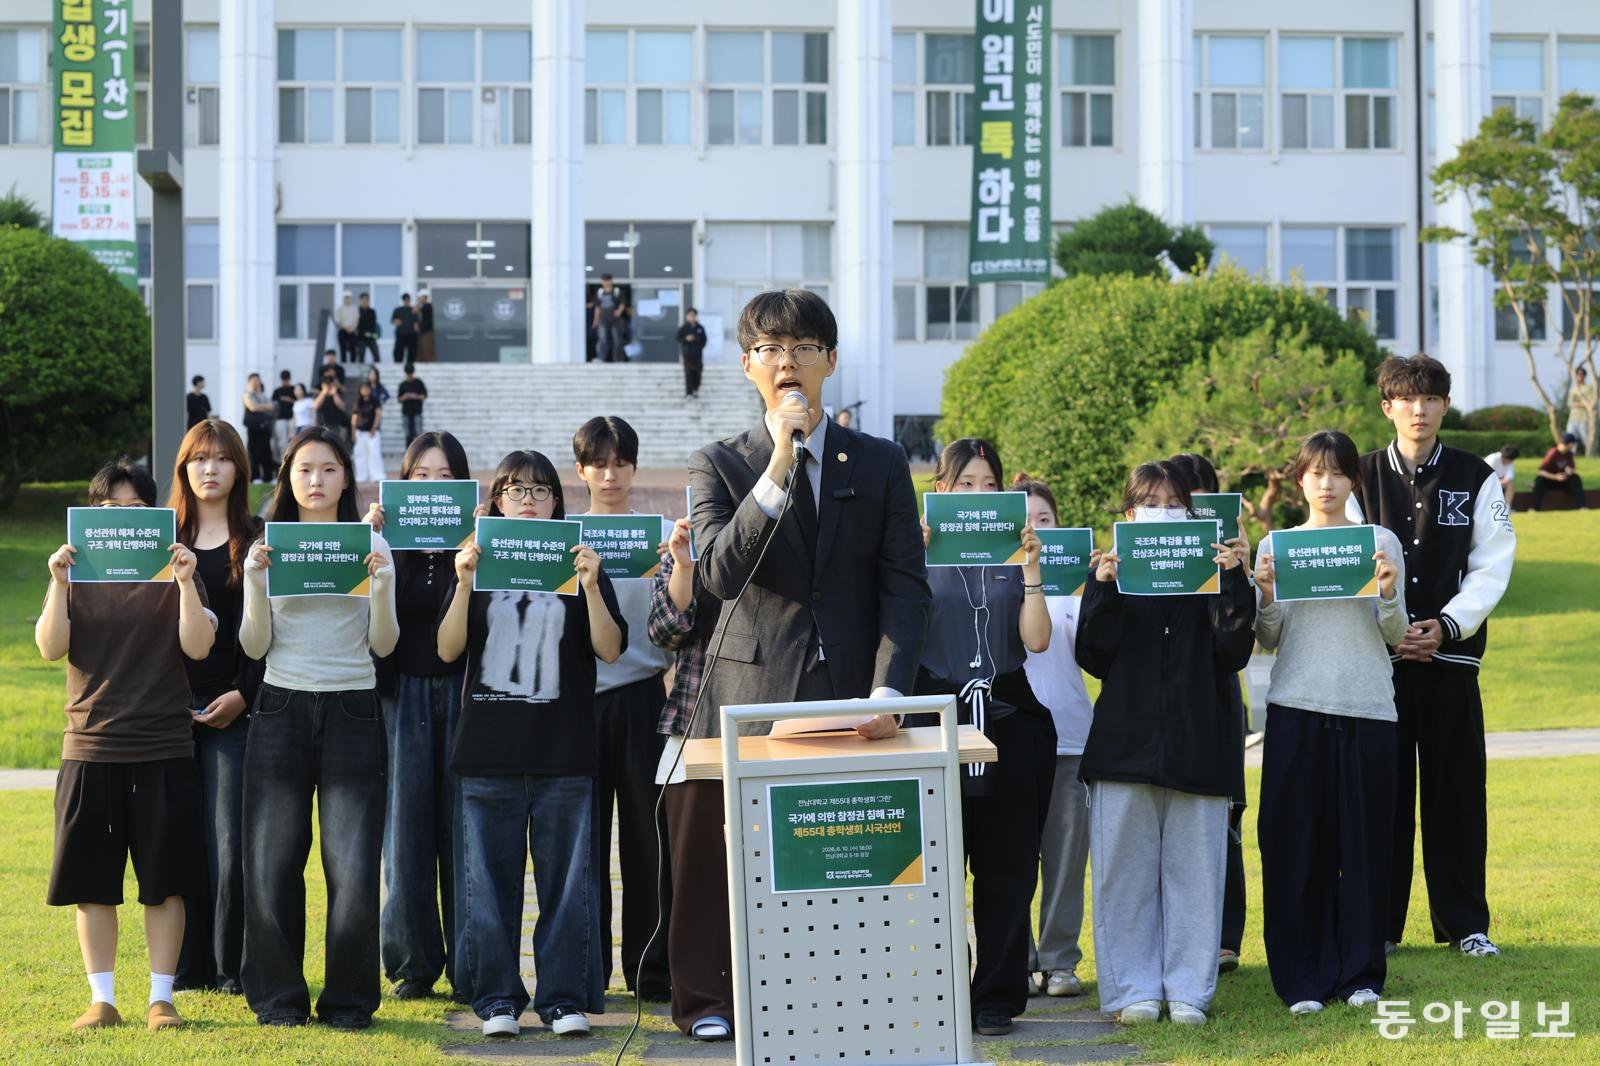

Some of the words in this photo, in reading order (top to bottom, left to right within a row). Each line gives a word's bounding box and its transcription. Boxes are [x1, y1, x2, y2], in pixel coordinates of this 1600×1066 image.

[102, 0, 129, 120] 기(1차)
[981, 34, 1015, 110] 읽고
[60, 71, 95, 146] 모집
[1024, 82, 1043, 152] 함께하는
[1023, 160, 1042, 178] 한
[1023, 184, 1042, 202] 책
[1023, 209, 1042, 243] 운동
[407, 495, 429, 504] 정부와
[430, 495, 453, 504] 국회는
[408, 506, 430, 515] 사안의
[431, 506, 461, 515] 중대성을
[1437, 489, 1469, 526] K
[957, 511, 980, 519] 국가에
[981, 510, 998, 519] 의한
[398, 517, 428, 527] 인지하고
[429, 517, 461, 527] 각성하라!
[939, 522, 963, 532] 참정권
[964, 522, 980, 532] 침해
[981, 522, 1014, 532] 규탄한다!
[84, 528, 117, 538] 중선관위
[118, 528, 135, 538] 해체
[136, 528, 160, 538] 수준의
[583, 529, 606, 538] 국조와
[606, 529, 630, 538] 특검을
[630, 529, 646, 538] 통한
[87, 541, 104, 550] 구조
[105, 541, 121, 550] 개혁
[122, 540, 158, 550] 단행하라!
[298, 541, 323, 551] 국가에
[324, 541, 341, 551] 의한
[491, 538, 523, 549] 중선관위
[524, 540, 540, 550] 해체
[541, 541, 566, 551] 수준의
[619, 540, 649, 550] 엄중처벌
[1134, 537, 1158, 546] 국조와
[1158, 536, 1183, 546] 특검을
[1184, 536, 1200, 546] 통한
[1048, 544, 1064, 553] 의한
[1132, 549, 1170, 559] 진상조사와
[1172, 548, 1204, 557] 엄중처벌
[1288, 547, 1320, 558] 중선관위
[1320, 546, 1337, 556] 해체
[1338, 544, 1362, 554] 수준의
[280, 553, 305, 562] 참정권
[306, 553, 323, 562] 침해
[324, 553, 359, 563] 규탄한다!
[493, 551, 509, 560] 구조
[511, 552, 527, 561] 개혁
[528, 553, 563, 563] 단행하라!
[1048, 556, 1080, 565] 규탄한다!
[1150, 560, 1185, 570] 단행하라!
[1291, 560, 1307, 569] 구조
[1308, 559, 1325, 568] 개혁
[1326, 557, 1361, 568] 단행하라!
[797, 798, 828, 807] 전남대학교
[829, 797, 850, 805] 제55대
[851, 796, 876, 805] 총학생회
[788, 812, 816, 824] 국가에
[817, 811, 836, 822] 의한
[837, 810, 865, 822] 참정권
[866, 809, 885, 821] 침해
[886, 808, 906, 819] 규탄
[793, 826, 825, 837] 제55대
[826, 824, 863, 836] 총학생회
[864, 822, 902, 834] 시국선언
